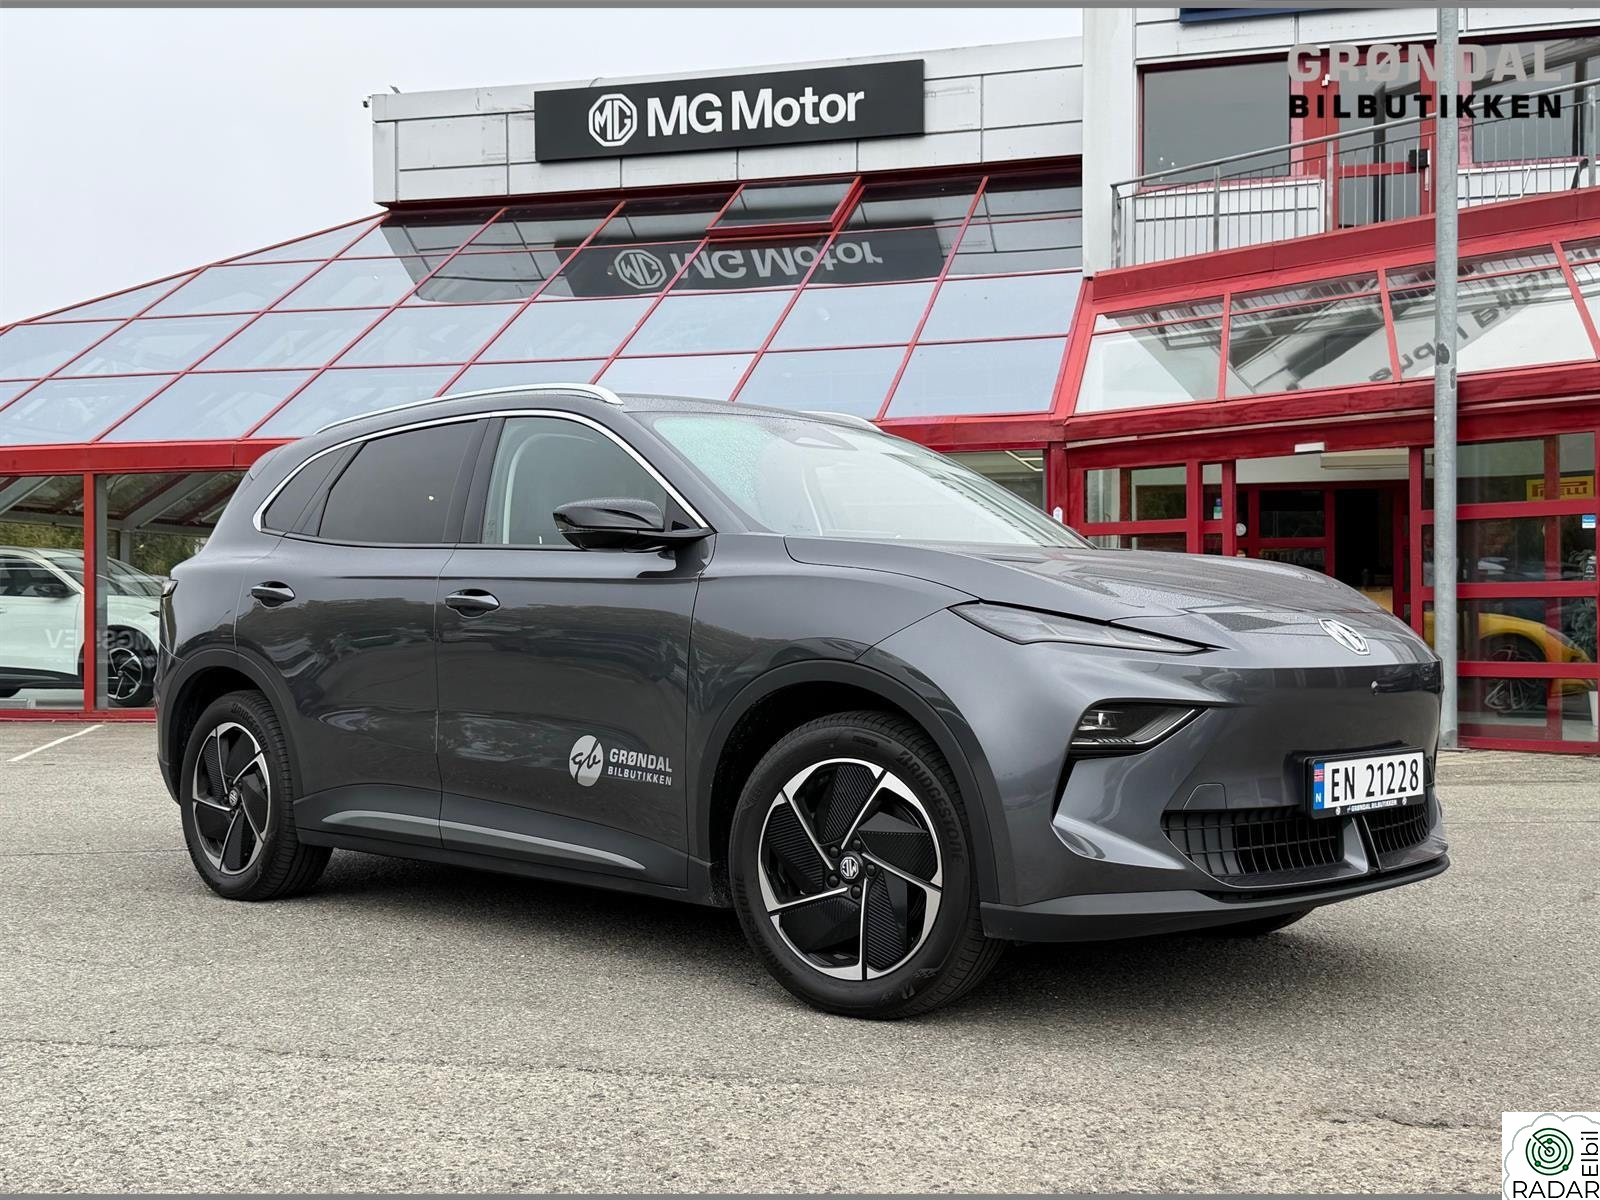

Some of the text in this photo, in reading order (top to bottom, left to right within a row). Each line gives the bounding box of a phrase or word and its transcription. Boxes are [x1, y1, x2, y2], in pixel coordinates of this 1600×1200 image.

[591, 87, 864, 145] MG MG Motor
[1532, 481, 1588, 497] PIELLI
[609, 748, 673, 773] GRØNDAL
[608, 765, 672, 786] BILBUTIKKEN
[1331, 758, 1419, 803] EN 21228
[1315, 792, 1322, 802] N
